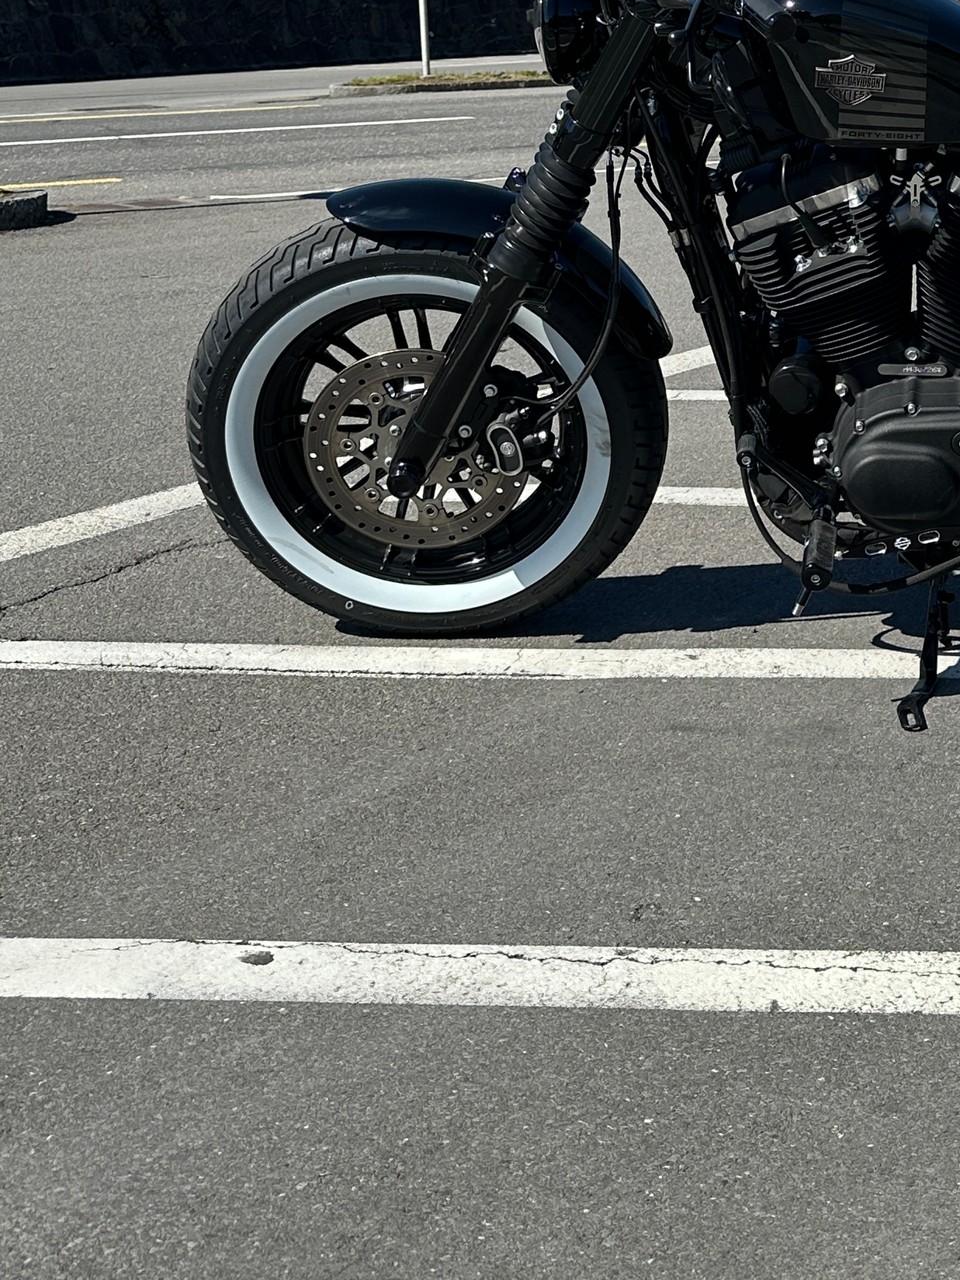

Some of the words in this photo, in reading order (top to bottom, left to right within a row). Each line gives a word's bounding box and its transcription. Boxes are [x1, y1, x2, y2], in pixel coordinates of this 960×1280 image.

[831, 61, 870, 74] MOTOR
[819, 73, 881, 89] HARLEY-DAVIDSON
[833, 88, 867, 102] CYCLES
[841, 130, 921, 140] FORTY-EIGHT
